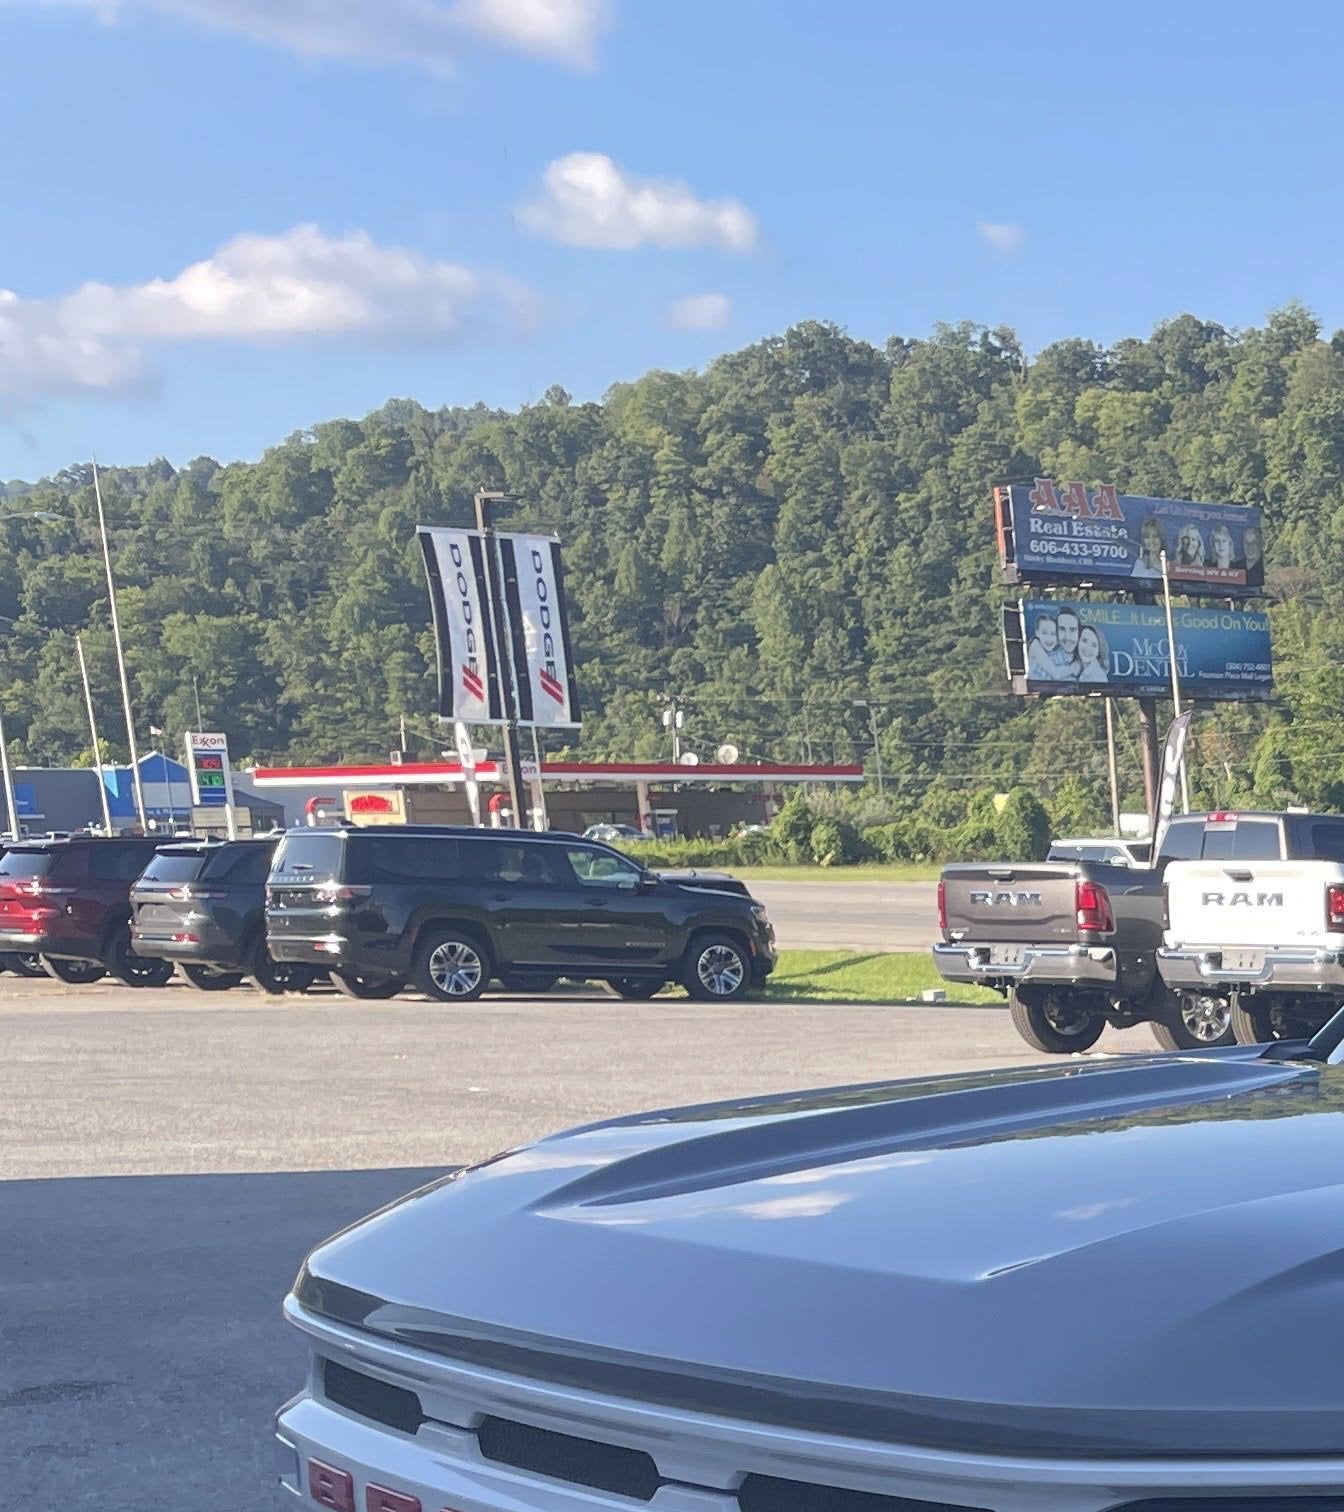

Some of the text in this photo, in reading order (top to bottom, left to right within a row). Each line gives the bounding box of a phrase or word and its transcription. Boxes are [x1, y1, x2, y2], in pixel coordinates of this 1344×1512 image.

[1029, 478, 1125, 521] AAA
[1029, 517, 1128, 539] Real Estate
[1030, 540, 1128, 559] 606-433-9700
[450, 543, 479, 679] DODGE
[531, 550, 558, 683] DODGE
[1182, 613, 1218, 629] Good
[1221, 615, 1241, 630] On
[1243, 616, 1270, 632] You!
[192, 735, 225, 748] Exxon
[969, 890, 1042, 906] RAM
[1201, 892, 1284, 907] RAM
